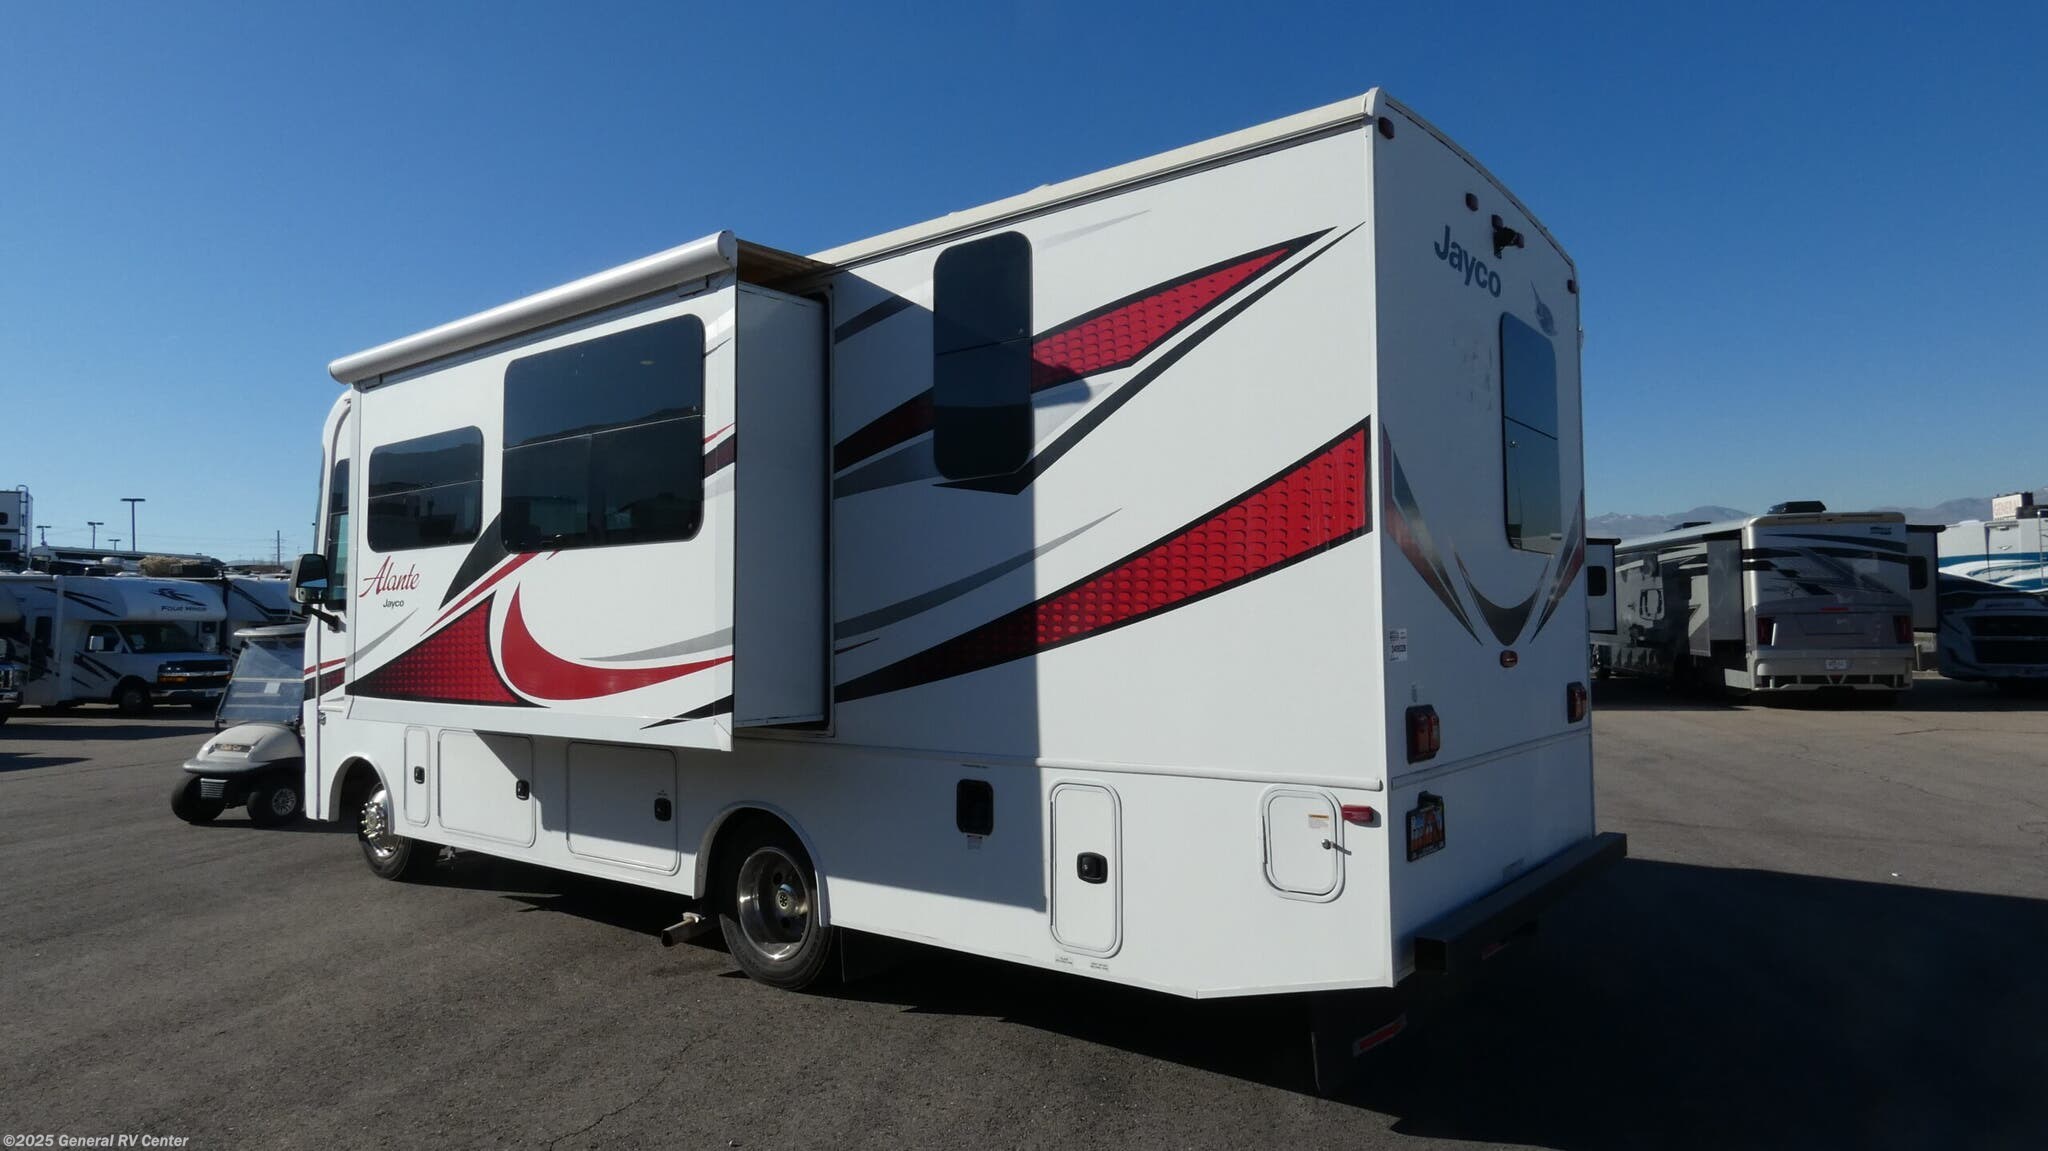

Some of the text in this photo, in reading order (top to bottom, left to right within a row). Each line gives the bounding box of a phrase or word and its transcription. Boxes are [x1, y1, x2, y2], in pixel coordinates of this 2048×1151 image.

[1434, 224, 1502, 298] Jayco
[359, 555, 420, 598] Alante
[383, 599, 405, 609] Jayco
